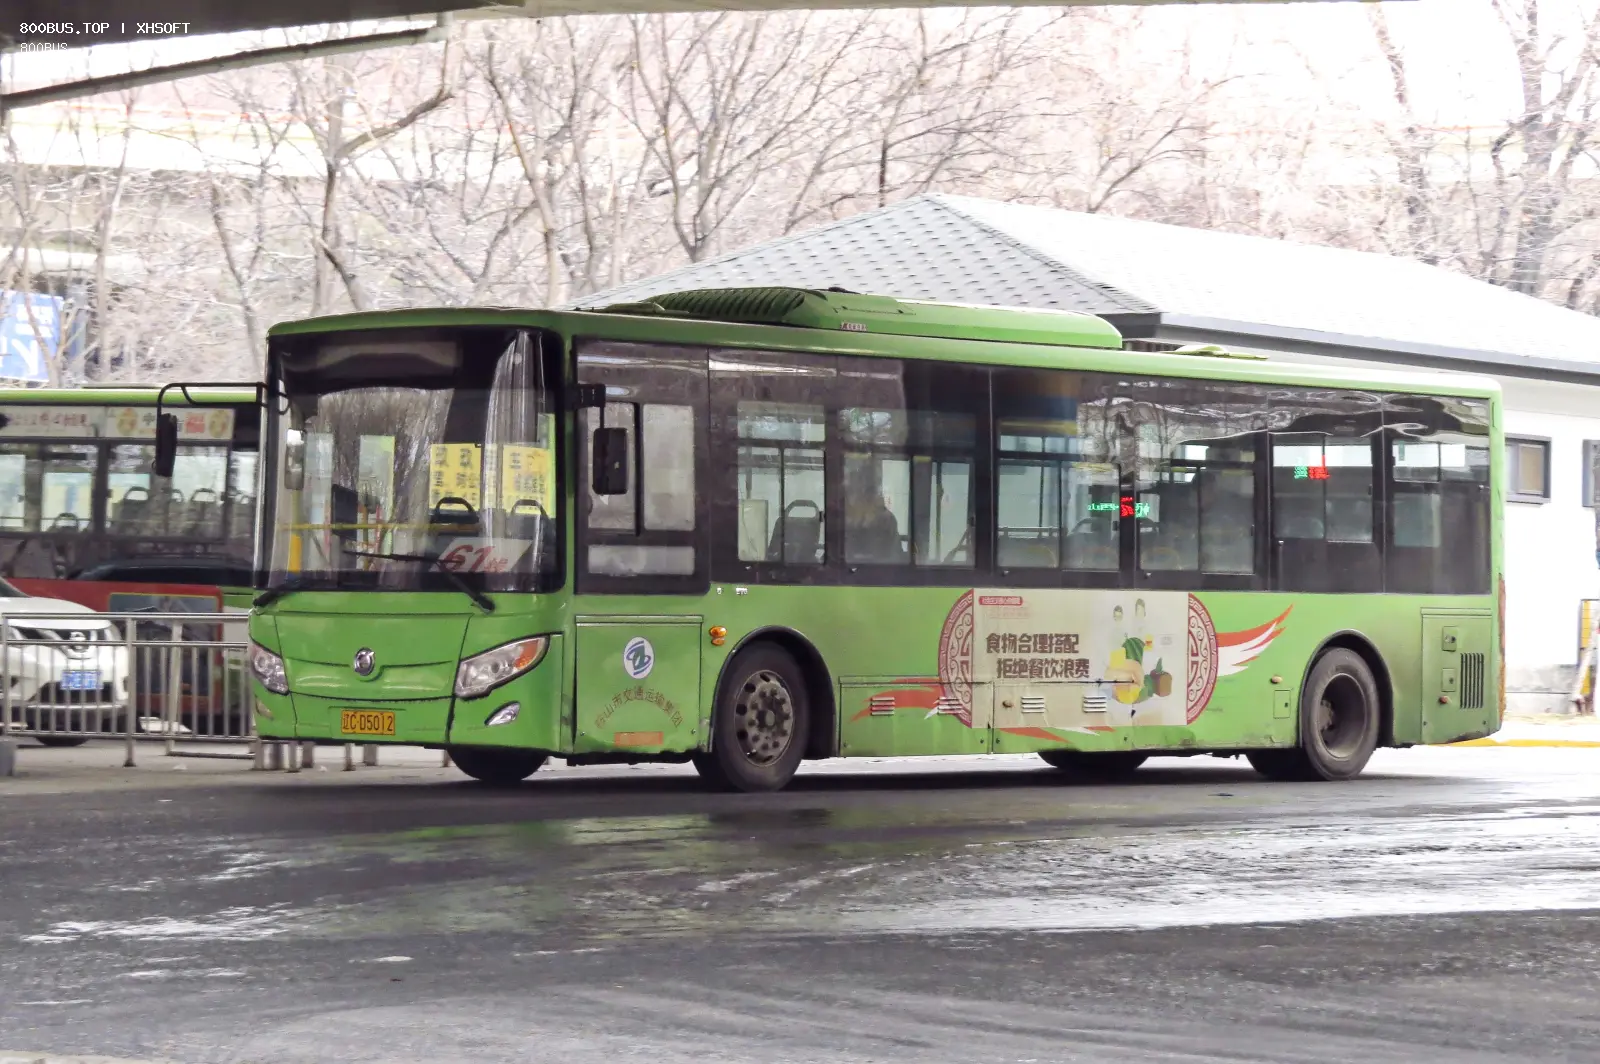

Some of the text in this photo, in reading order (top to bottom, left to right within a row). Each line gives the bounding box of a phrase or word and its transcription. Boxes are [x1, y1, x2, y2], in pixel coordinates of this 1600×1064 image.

[985, 632, 1080, 654] 食物合理搭配
[996, 657, 1090, 679] 拒绝餐饮浪费
